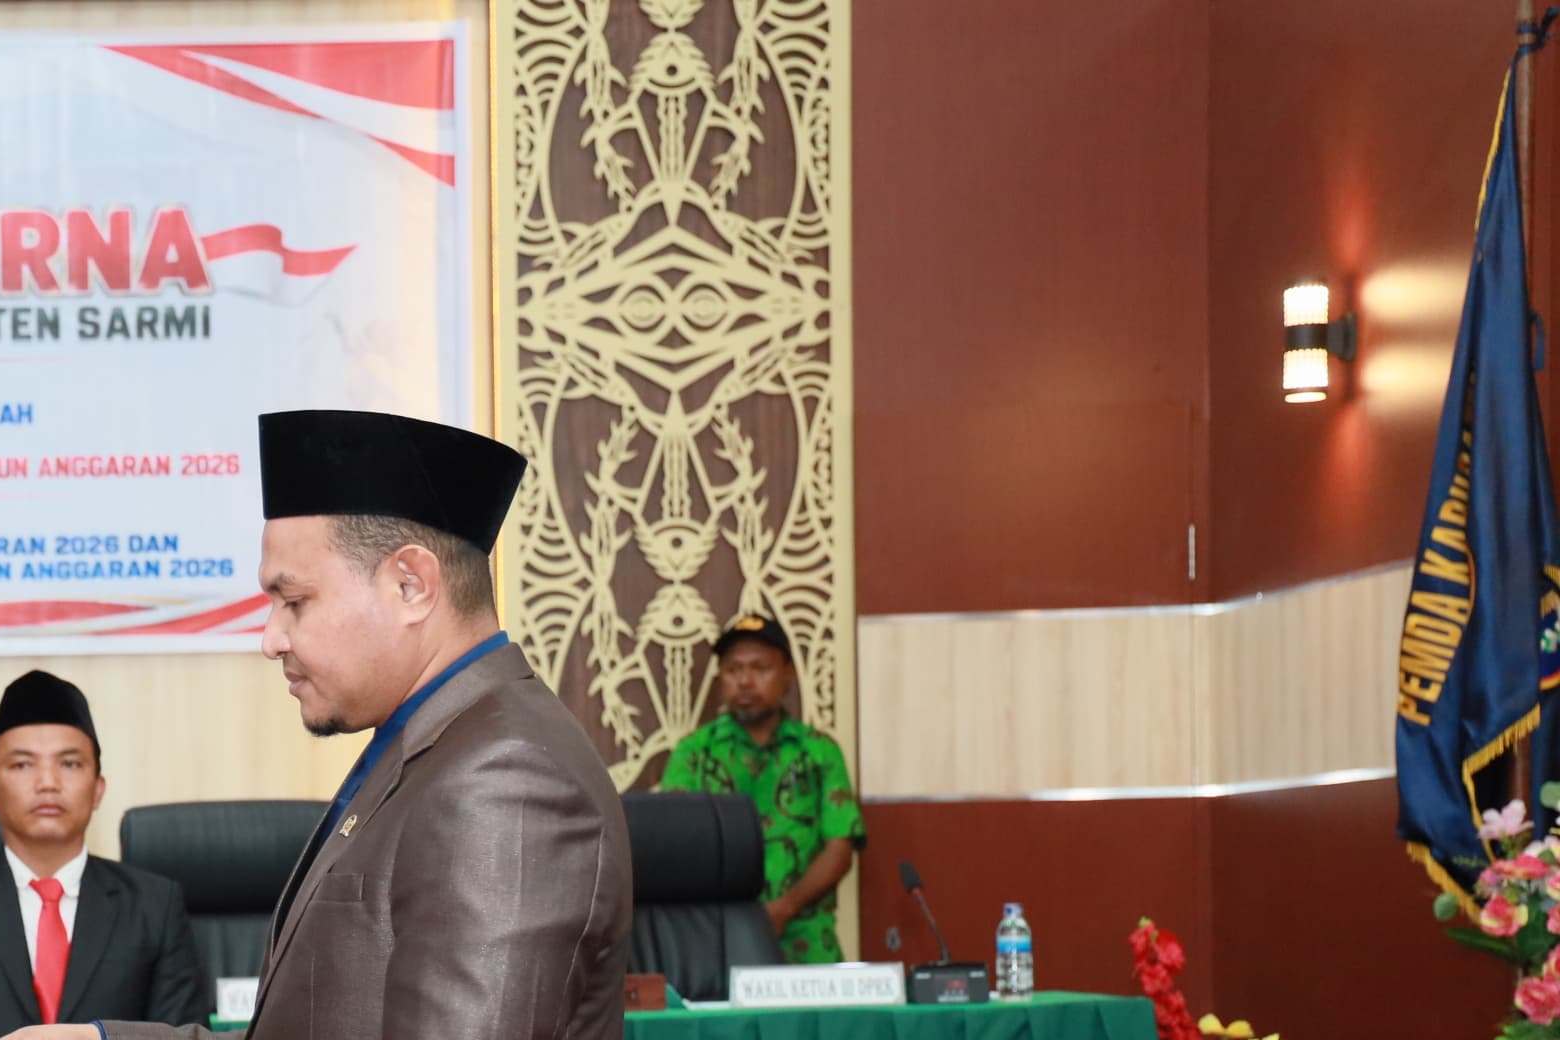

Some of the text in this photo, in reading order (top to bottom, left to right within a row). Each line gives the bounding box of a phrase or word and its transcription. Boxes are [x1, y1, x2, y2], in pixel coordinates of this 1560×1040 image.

[77, 305, 212, 341] SARMI
[38, 455, 172, 478] ANGGARAN
[180, 454, 241, 476] 2026
[55, 536, 120, 554] 2026
[128, 535, 180, 553] DAN
[21, 560, 161, 580] ANGGARAN
[169, 558, 234, 577] 2026
[1397, 589, 1472, 727] PEMDA
